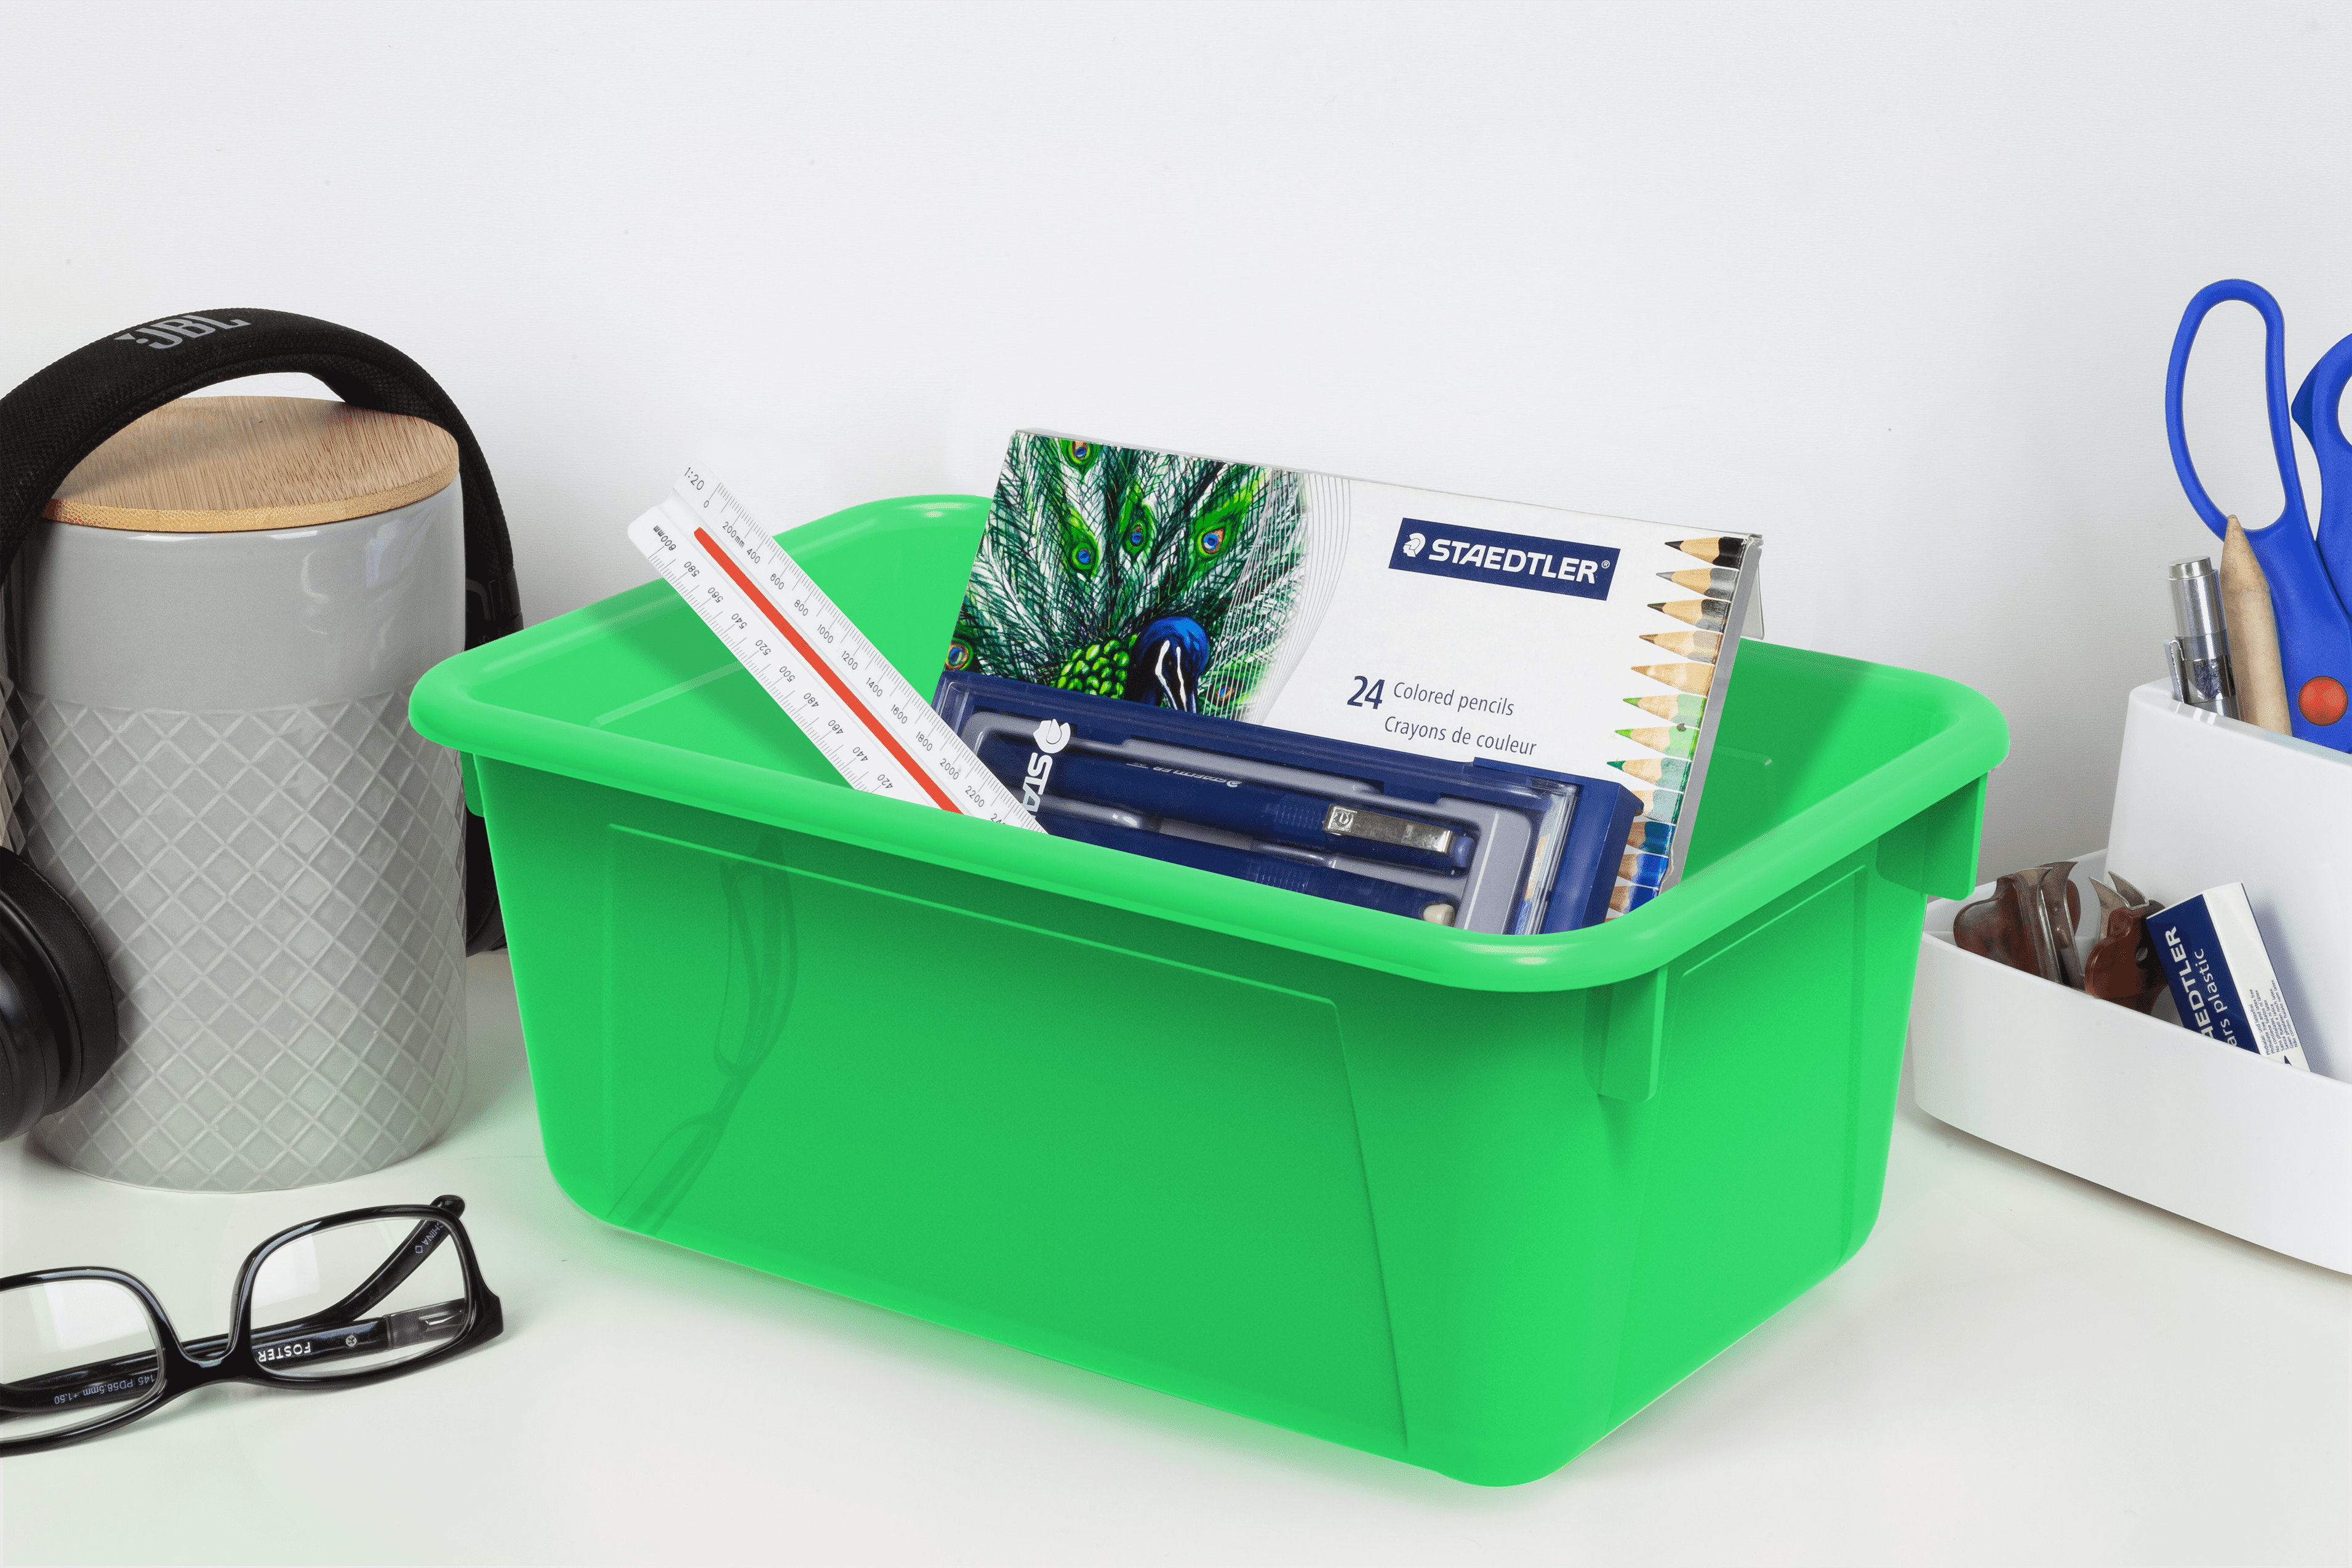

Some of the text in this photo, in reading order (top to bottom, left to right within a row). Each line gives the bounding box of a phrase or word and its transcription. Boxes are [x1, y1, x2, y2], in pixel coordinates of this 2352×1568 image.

[684, 467, 705, 490] 1:20
[653, 526, 894, 790] 420 440 460 480 500 520 540 560 580 600mm
[703, 500, 710, 508] 0
[722, 521, 745, 548] 200mm
[746, 548, 761, 564] 400
[770, 574, 785, 590] 600
[794, 599, 809, 616] 800
[817, 624, 834, 644] 1000
[841, 650, 858, 670] 1200
[866, 678, 883, 698] 1400
[890, 704, 908, 724] 1600
[915, 731, 933, 751] 1800
[940, 758, 959, 780] 2000
[965, 785, 985, 807] 2200
[1346, 675, 1514, 716] 24 Colored pencils
[1385, 716, 1537, 756] Crayons de couleur
[1022, 752, 1053, 818] STA
[2165, 926, 2214, 1039] AEDTLER
[2194, 948, 2238, 1046] ars plastic
[258, 1342, 311, 1362] FOSTER
[54, 1375, 155, 1404] 145 PD58.5mm +1.50
